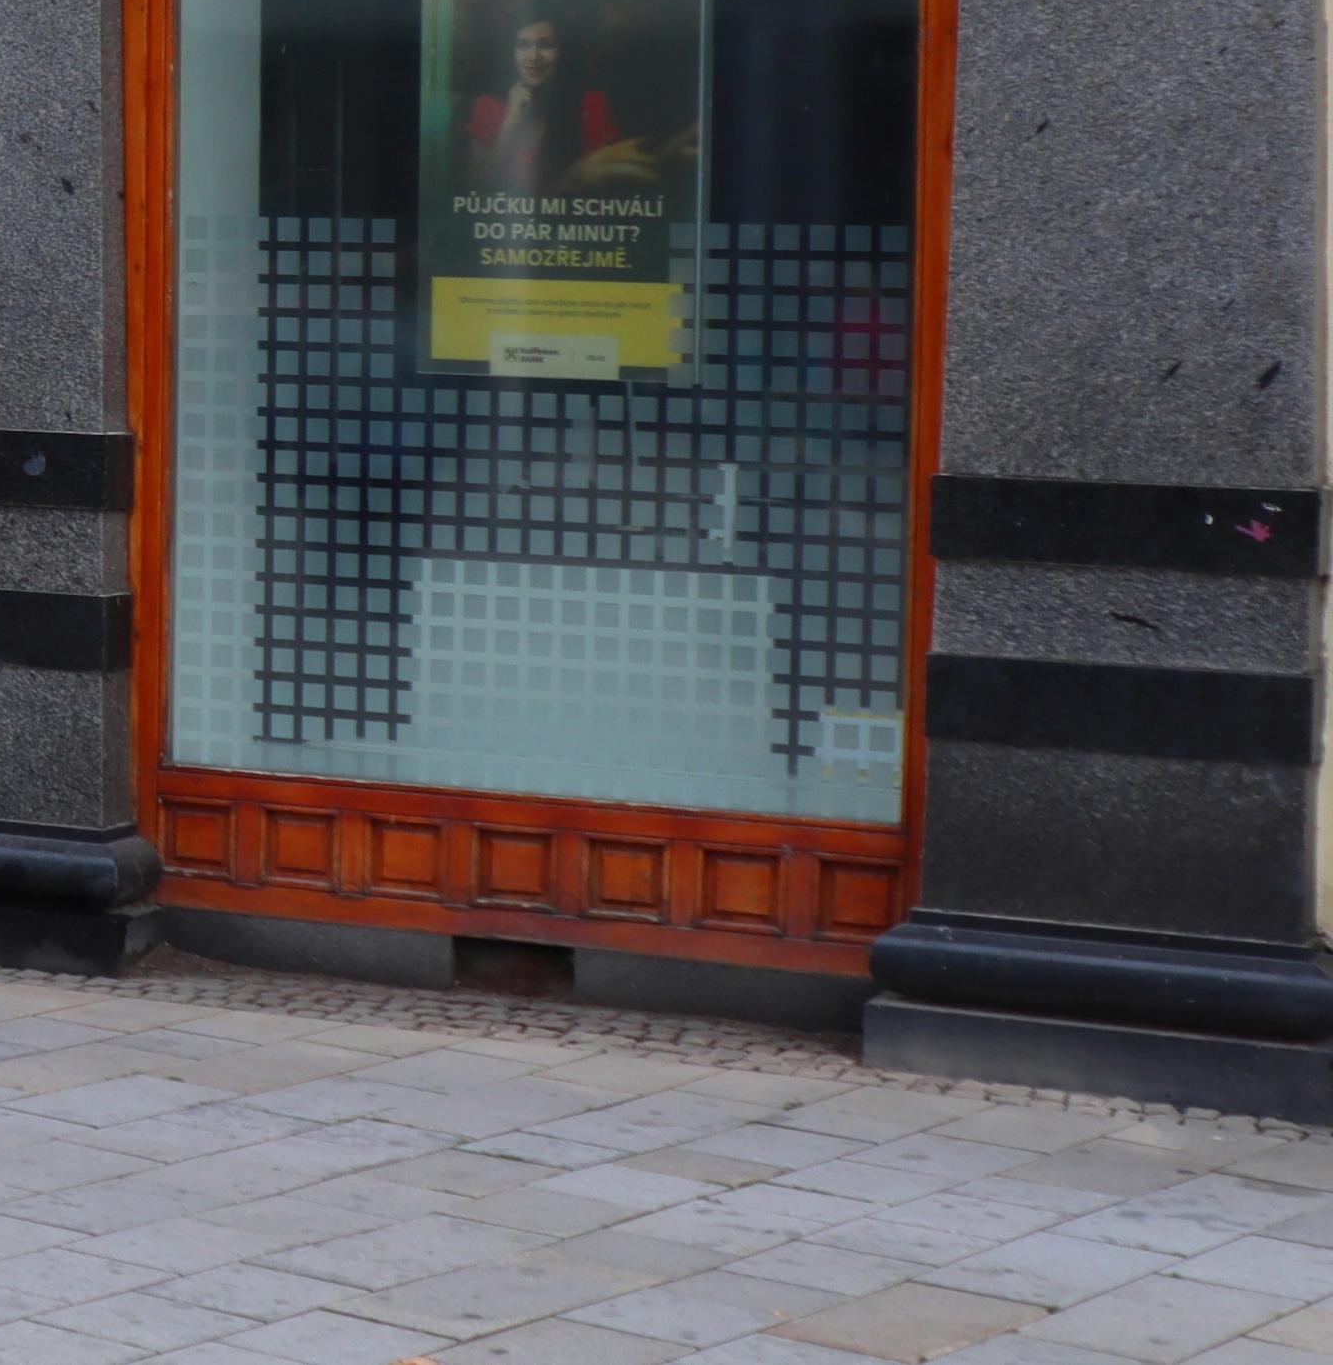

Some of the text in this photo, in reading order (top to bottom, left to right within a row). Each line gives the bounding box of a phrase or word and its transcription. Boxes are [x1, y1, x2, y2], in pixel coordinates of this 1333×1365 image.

[452, 191, 665, 217] PŮJČKU MI SCHVÁLÍ
[474, 219, 641, 243] DO PÁR MINUT?
[480, 245, 633, 269] SAMOZŘEJMĚ.
